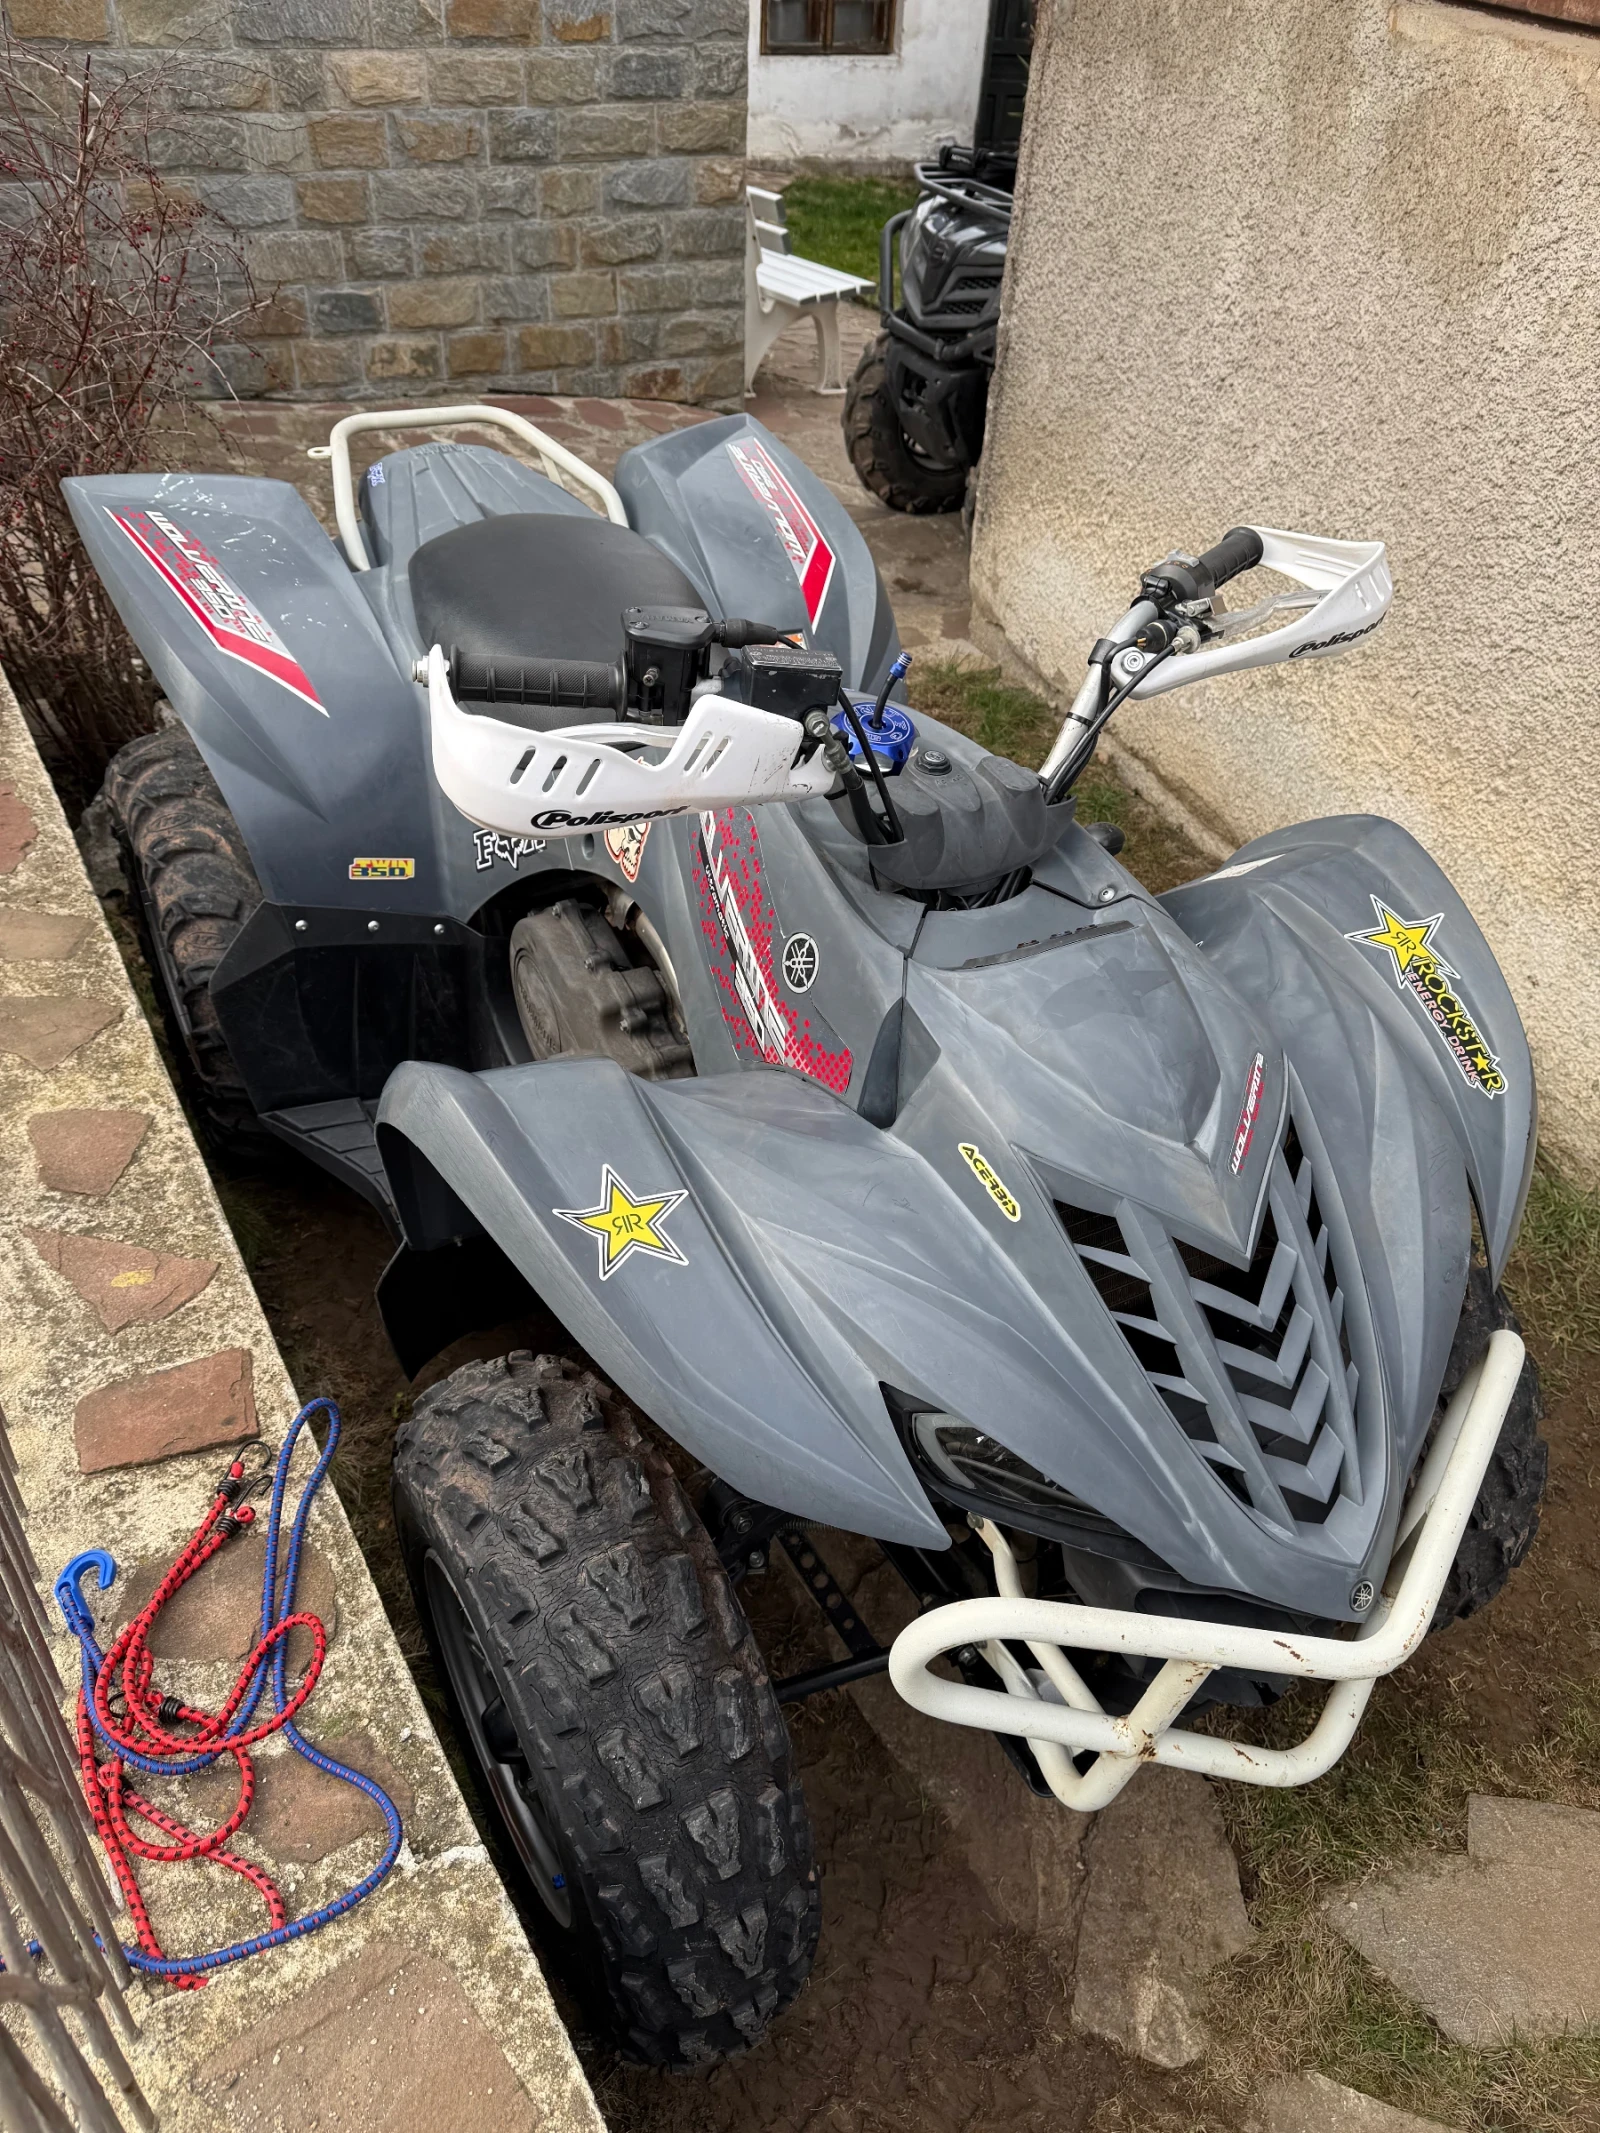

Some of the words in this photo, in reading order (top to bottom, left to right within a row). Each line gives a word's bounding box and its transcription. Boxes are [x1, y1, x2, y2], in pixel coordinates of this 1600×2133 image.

[727, 444, 806, 559] WOLVERINE
[751, 459, 778, 491] 350
[145, 510, 270, 643] WOLVERINE
[192, 575, 232, 619] 350
[531, 805, 692, 829] Polisport
[352, 867, 405, 876] 350
[355, 860, 413, 876] TWIN
[734, 960, 765, 1054] 350
[1407, 973, 1451, 1030] ENERGY
[1447, 1036, 1480, 1086] DRINK
[1232, 1052, 1264, 1174] WOLVERINE
